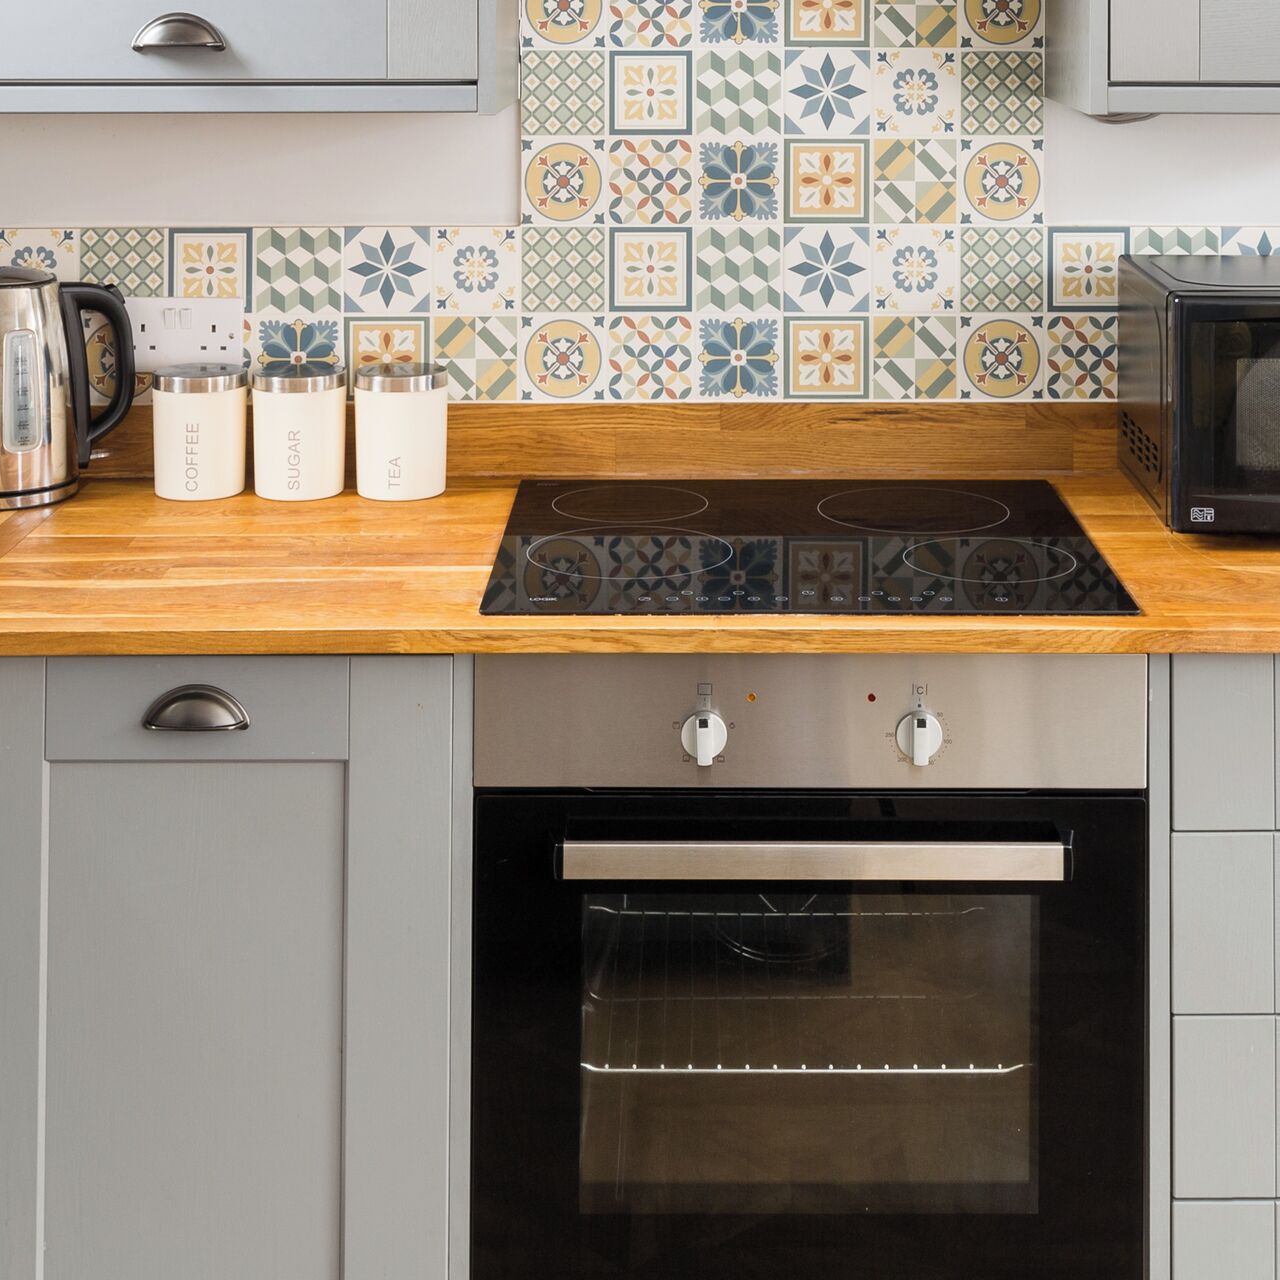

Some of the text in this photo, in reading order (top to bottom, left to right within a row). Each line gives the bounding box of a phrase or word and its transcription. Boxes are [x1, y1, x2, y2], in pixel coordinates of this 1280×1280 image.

[185, 422, 199, 492] COFFEE
[287, 429, 301, 491] SUGAR
[387, 455, 401, 489] TEA
